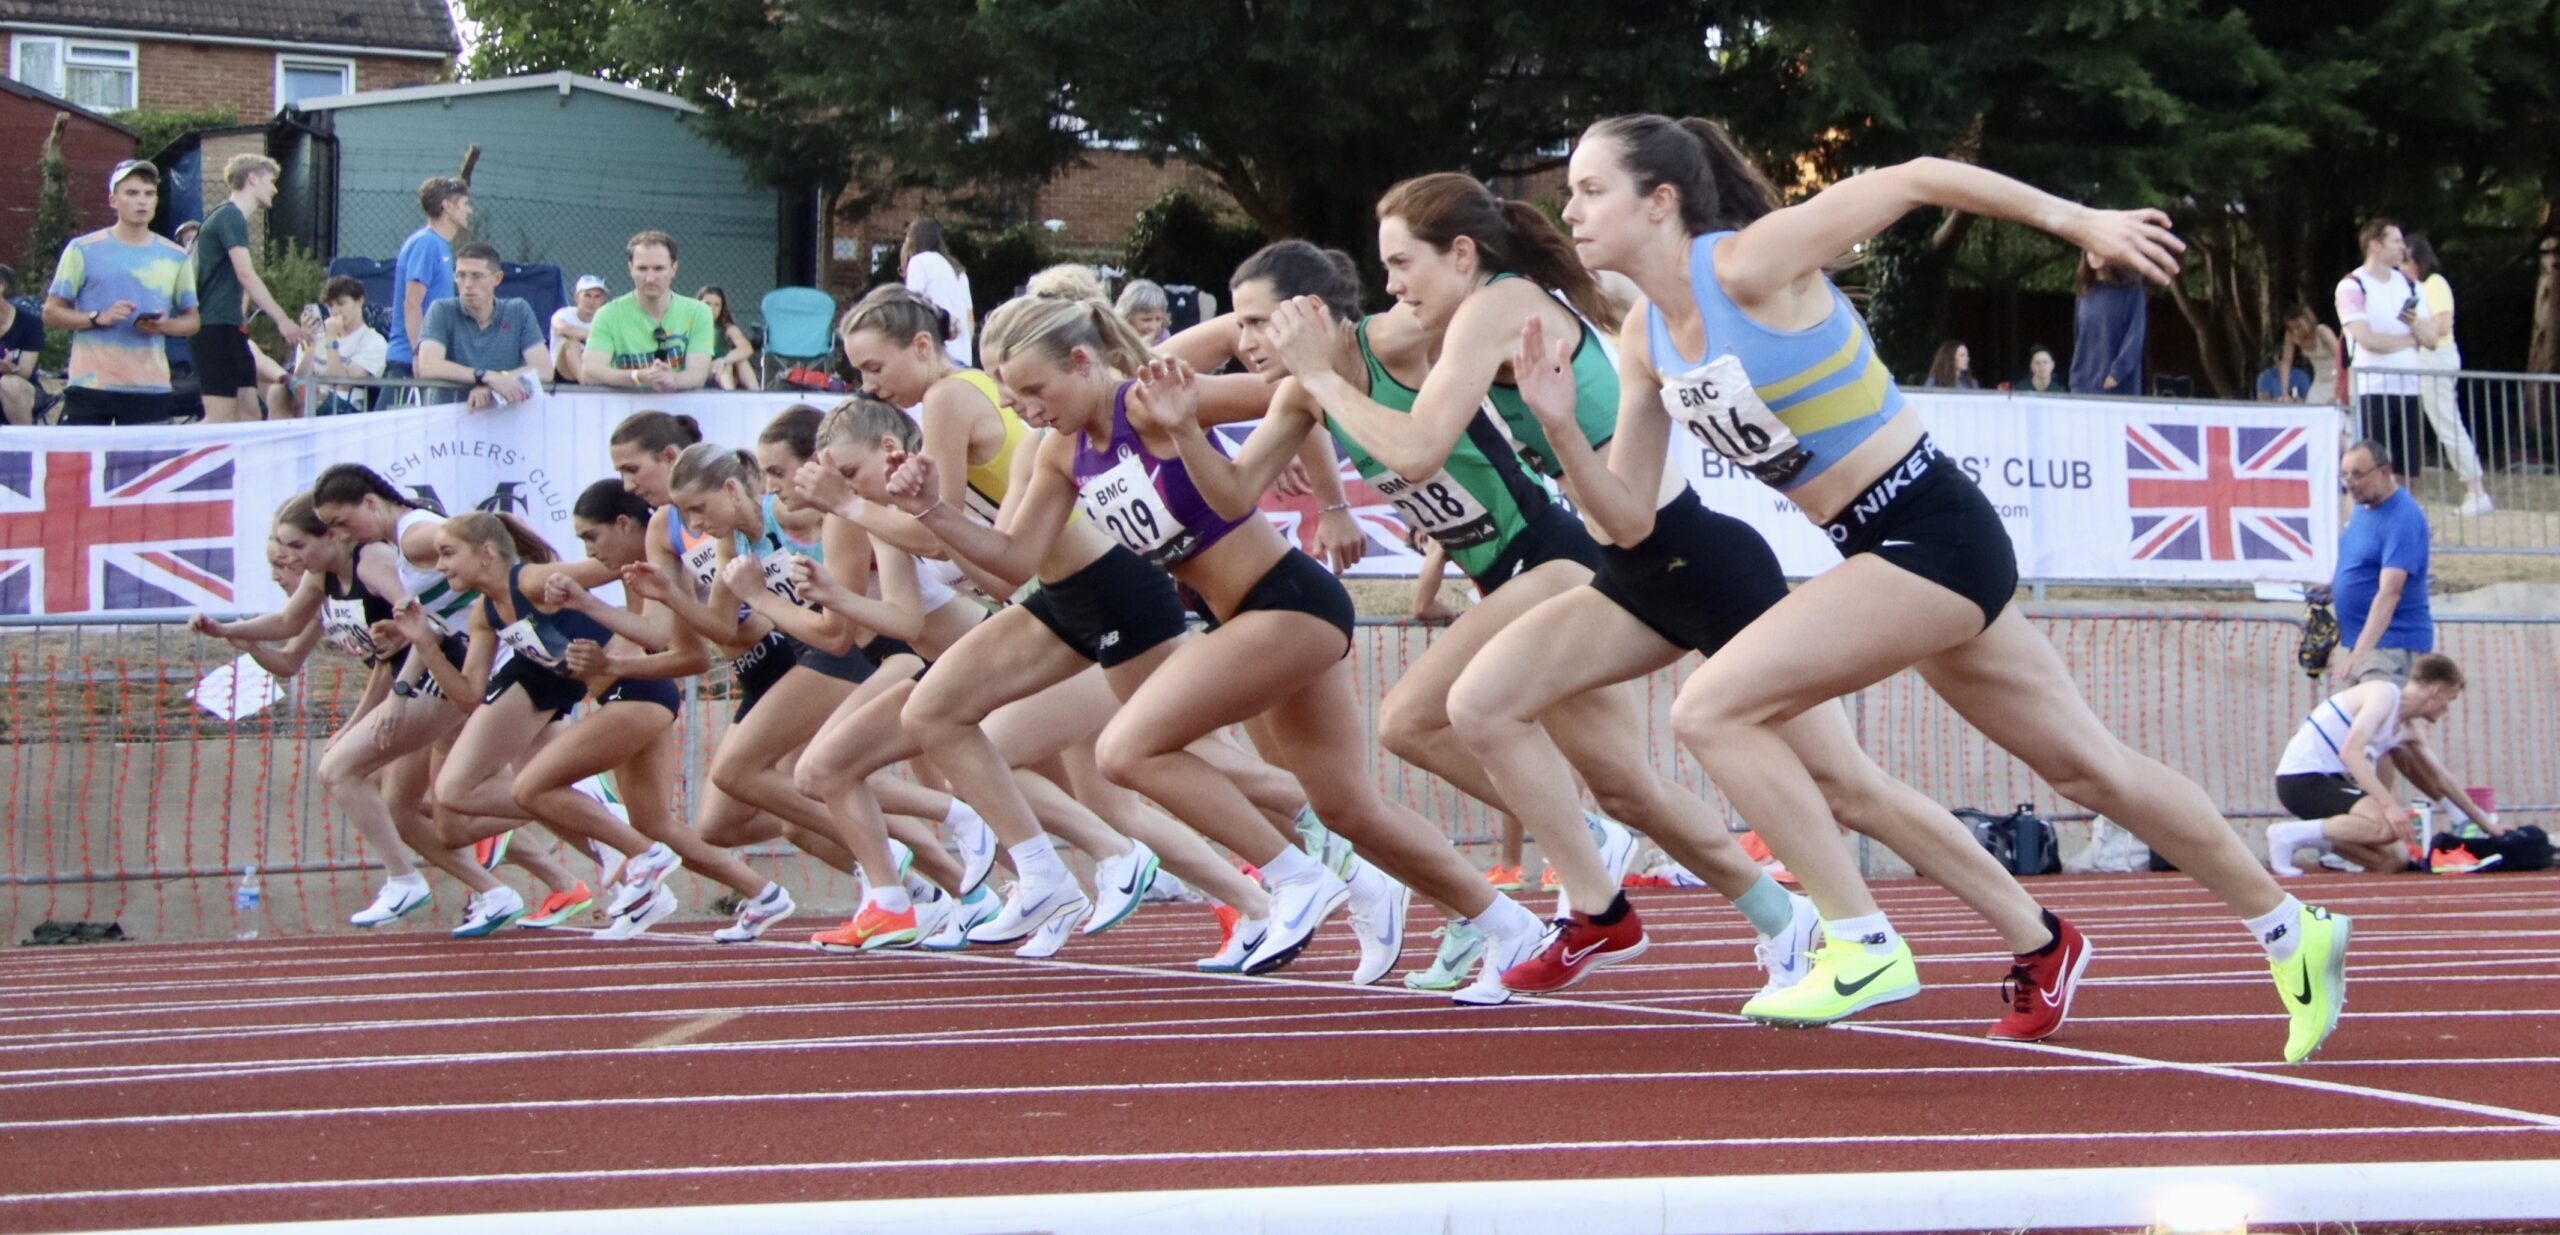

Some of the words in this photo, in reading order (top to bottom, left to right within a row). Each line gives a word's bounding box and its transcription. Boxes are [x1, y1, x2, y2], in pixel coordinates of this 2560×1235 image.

[1678, 381, 1719, 407] BMC
[1688, 407, 1771, 459] 216
[2003, 457, 2093, 490] CLUB
[529, 468, 567, 523] CLUB
[1095, 478, 1128, 506] BMC
[1395, 482, 1465, 528] 218
[1106, 498, 1160, 550] 219
[692, 547, 716, 568] BMC
[764, 563, 781, 578] MC
